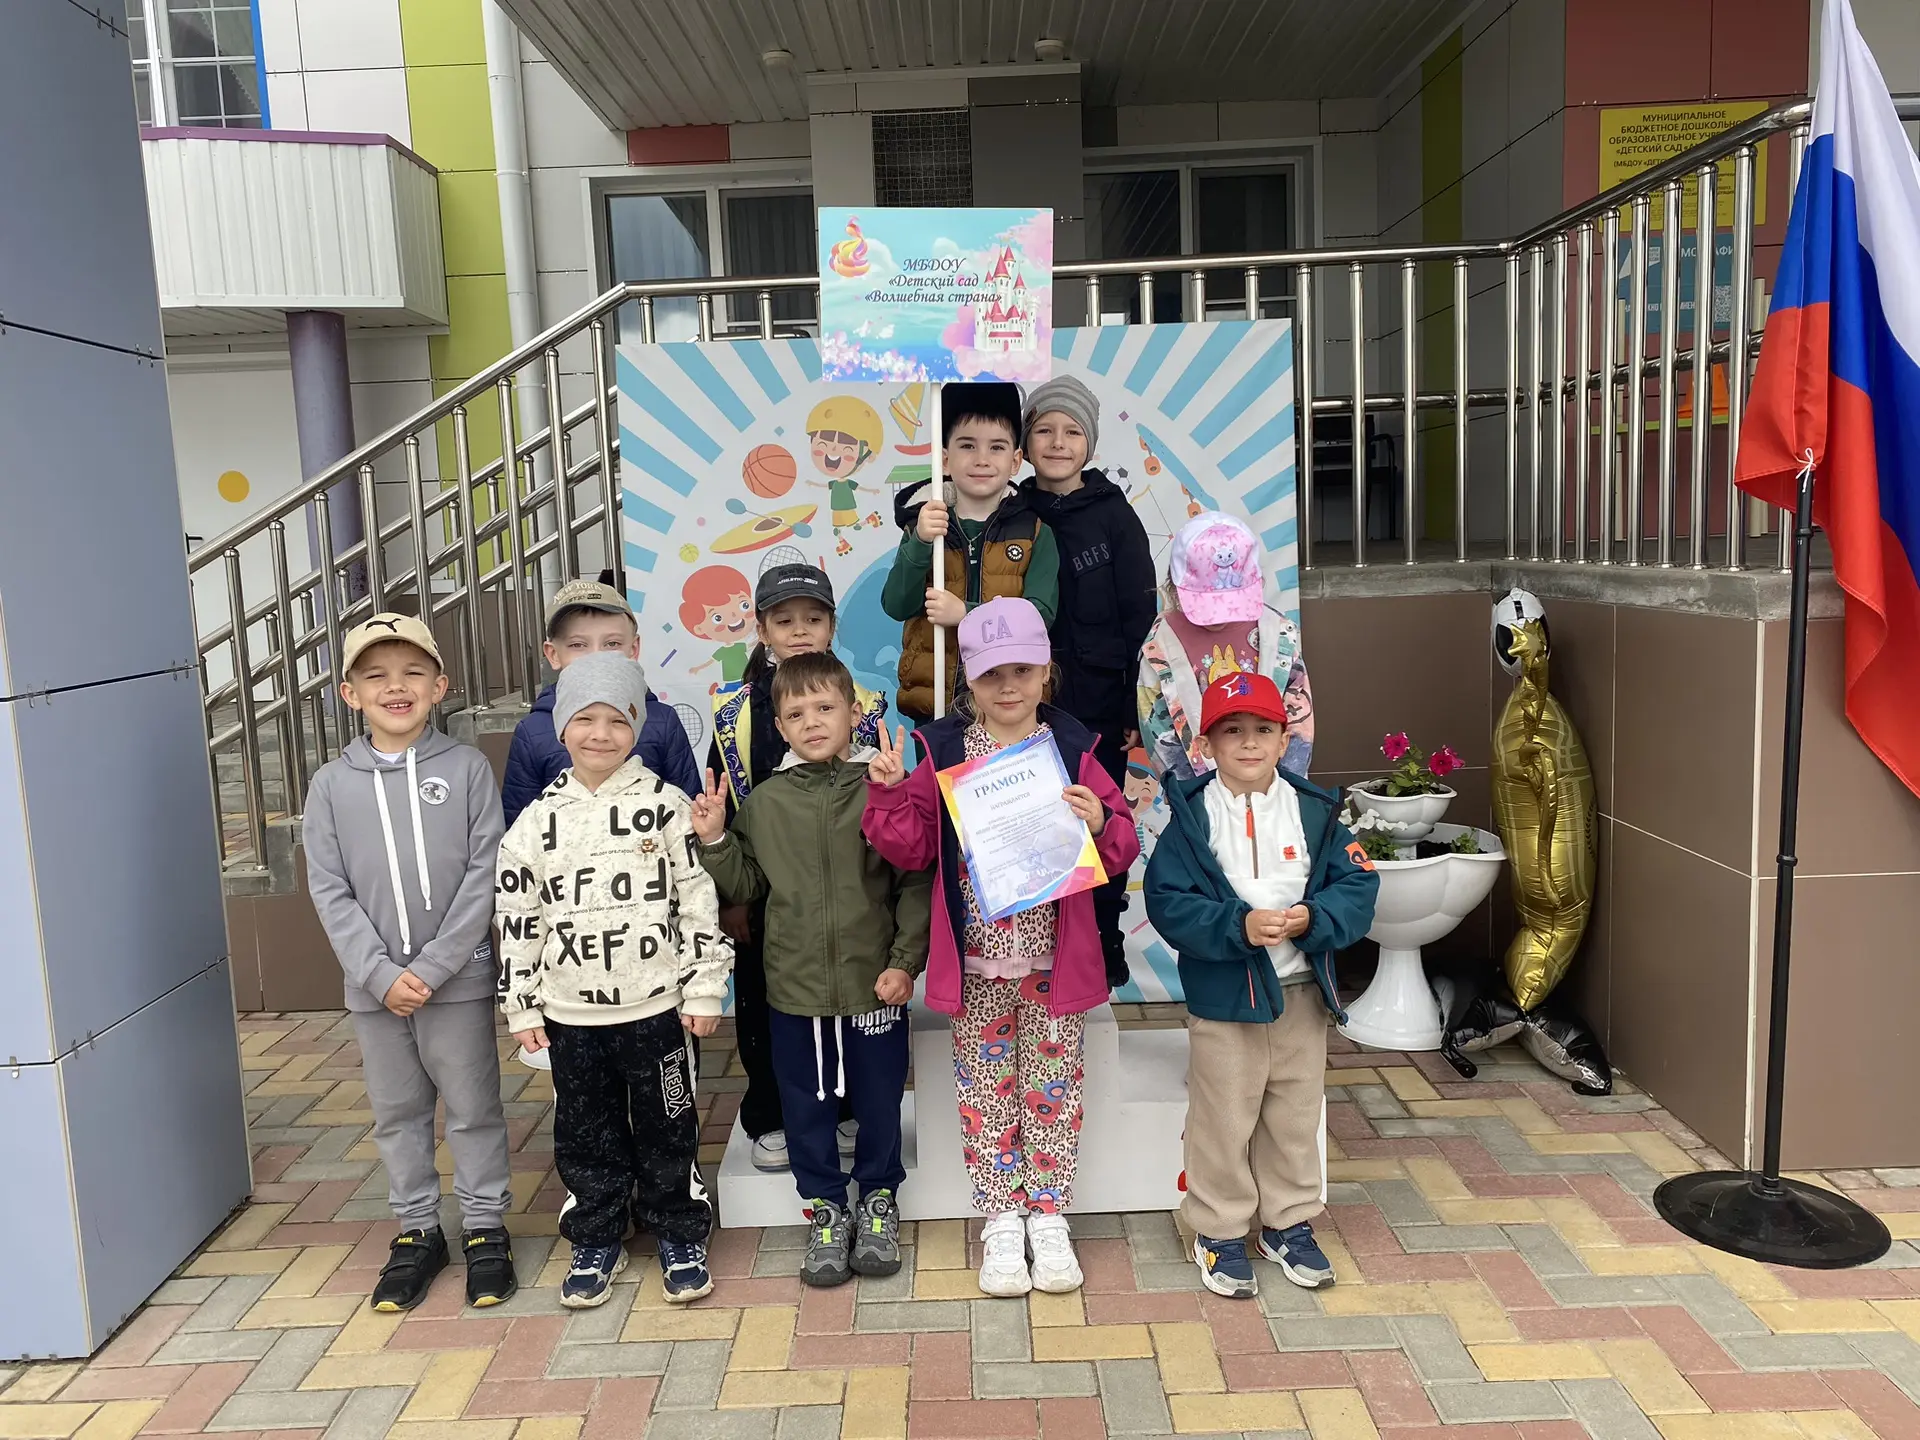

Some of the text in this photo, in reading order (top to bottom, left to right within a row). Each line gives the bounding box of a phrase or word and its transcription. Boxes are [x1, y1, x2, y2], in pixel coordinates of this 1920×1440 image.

[1643, 110, 1727, 122] МУНИЦИПАЛЬНОЕ
[1621, 120, 1742, 134] БЮДЖЕТНОЕ ДОШКОЛЬНО
[1609, 134, 1697, 145] ОБРАЗОВАТЕЛЬНОЕ
[1616, 143, 1661, 155] «ДЕТСКИЙ
[1664, 143, 1682, 153] САД
[903, 257, 967, 273] МБДОУ
[888, 273, 979, 288] «Детский сад
[864, 288, 1002, 307] «Волшебная страна»
[575, 582, 603, 591] YORK
[981, 615, 1013, 644] CA
[974, 768, 1036, 798] ГРАМОТА
[851, 1005, 902, 1028] FOOTBALL
